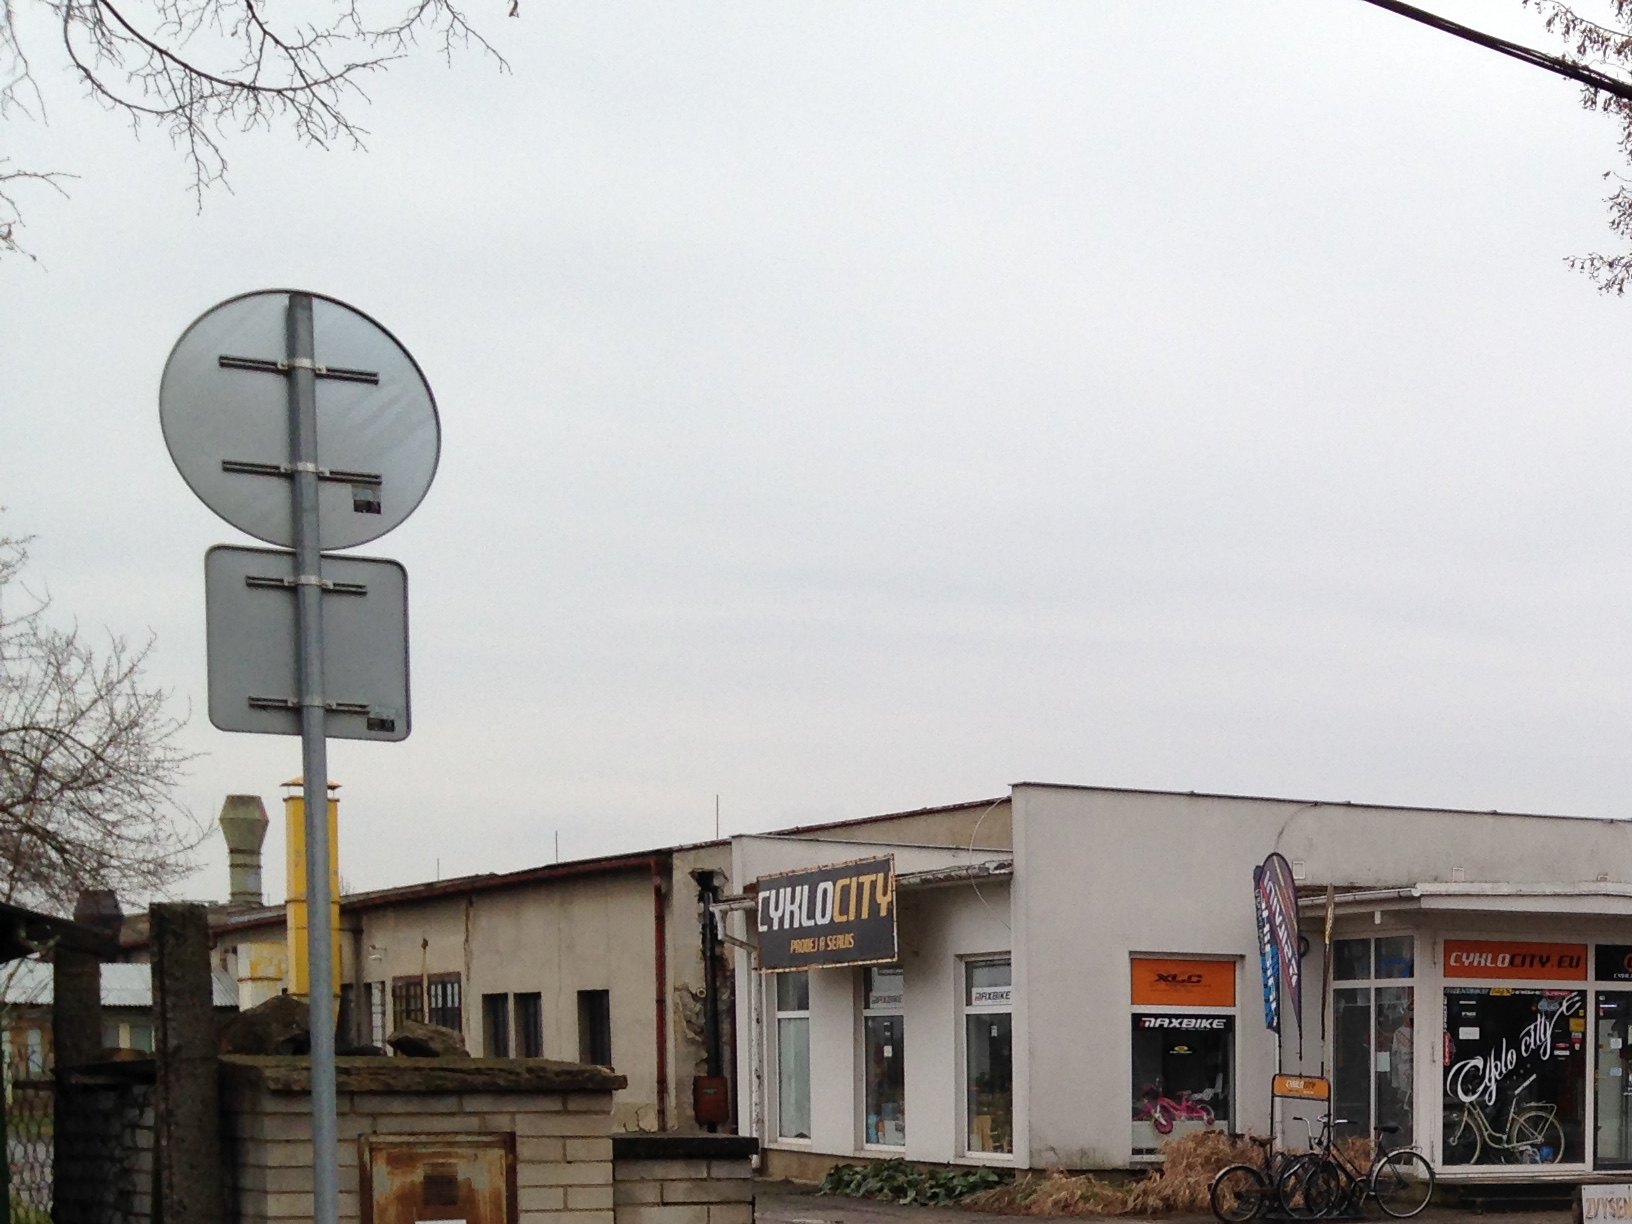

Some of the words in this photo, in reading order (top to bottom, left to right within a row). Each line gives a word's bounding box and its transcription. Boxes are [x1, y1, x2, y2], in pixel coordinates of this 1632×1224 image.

[758, 871, 893, 932] CYKLOCITY
[1154, 973, 1202, 984] XLC
[1140, 1018, 1226, 1029] MAXBIKE
